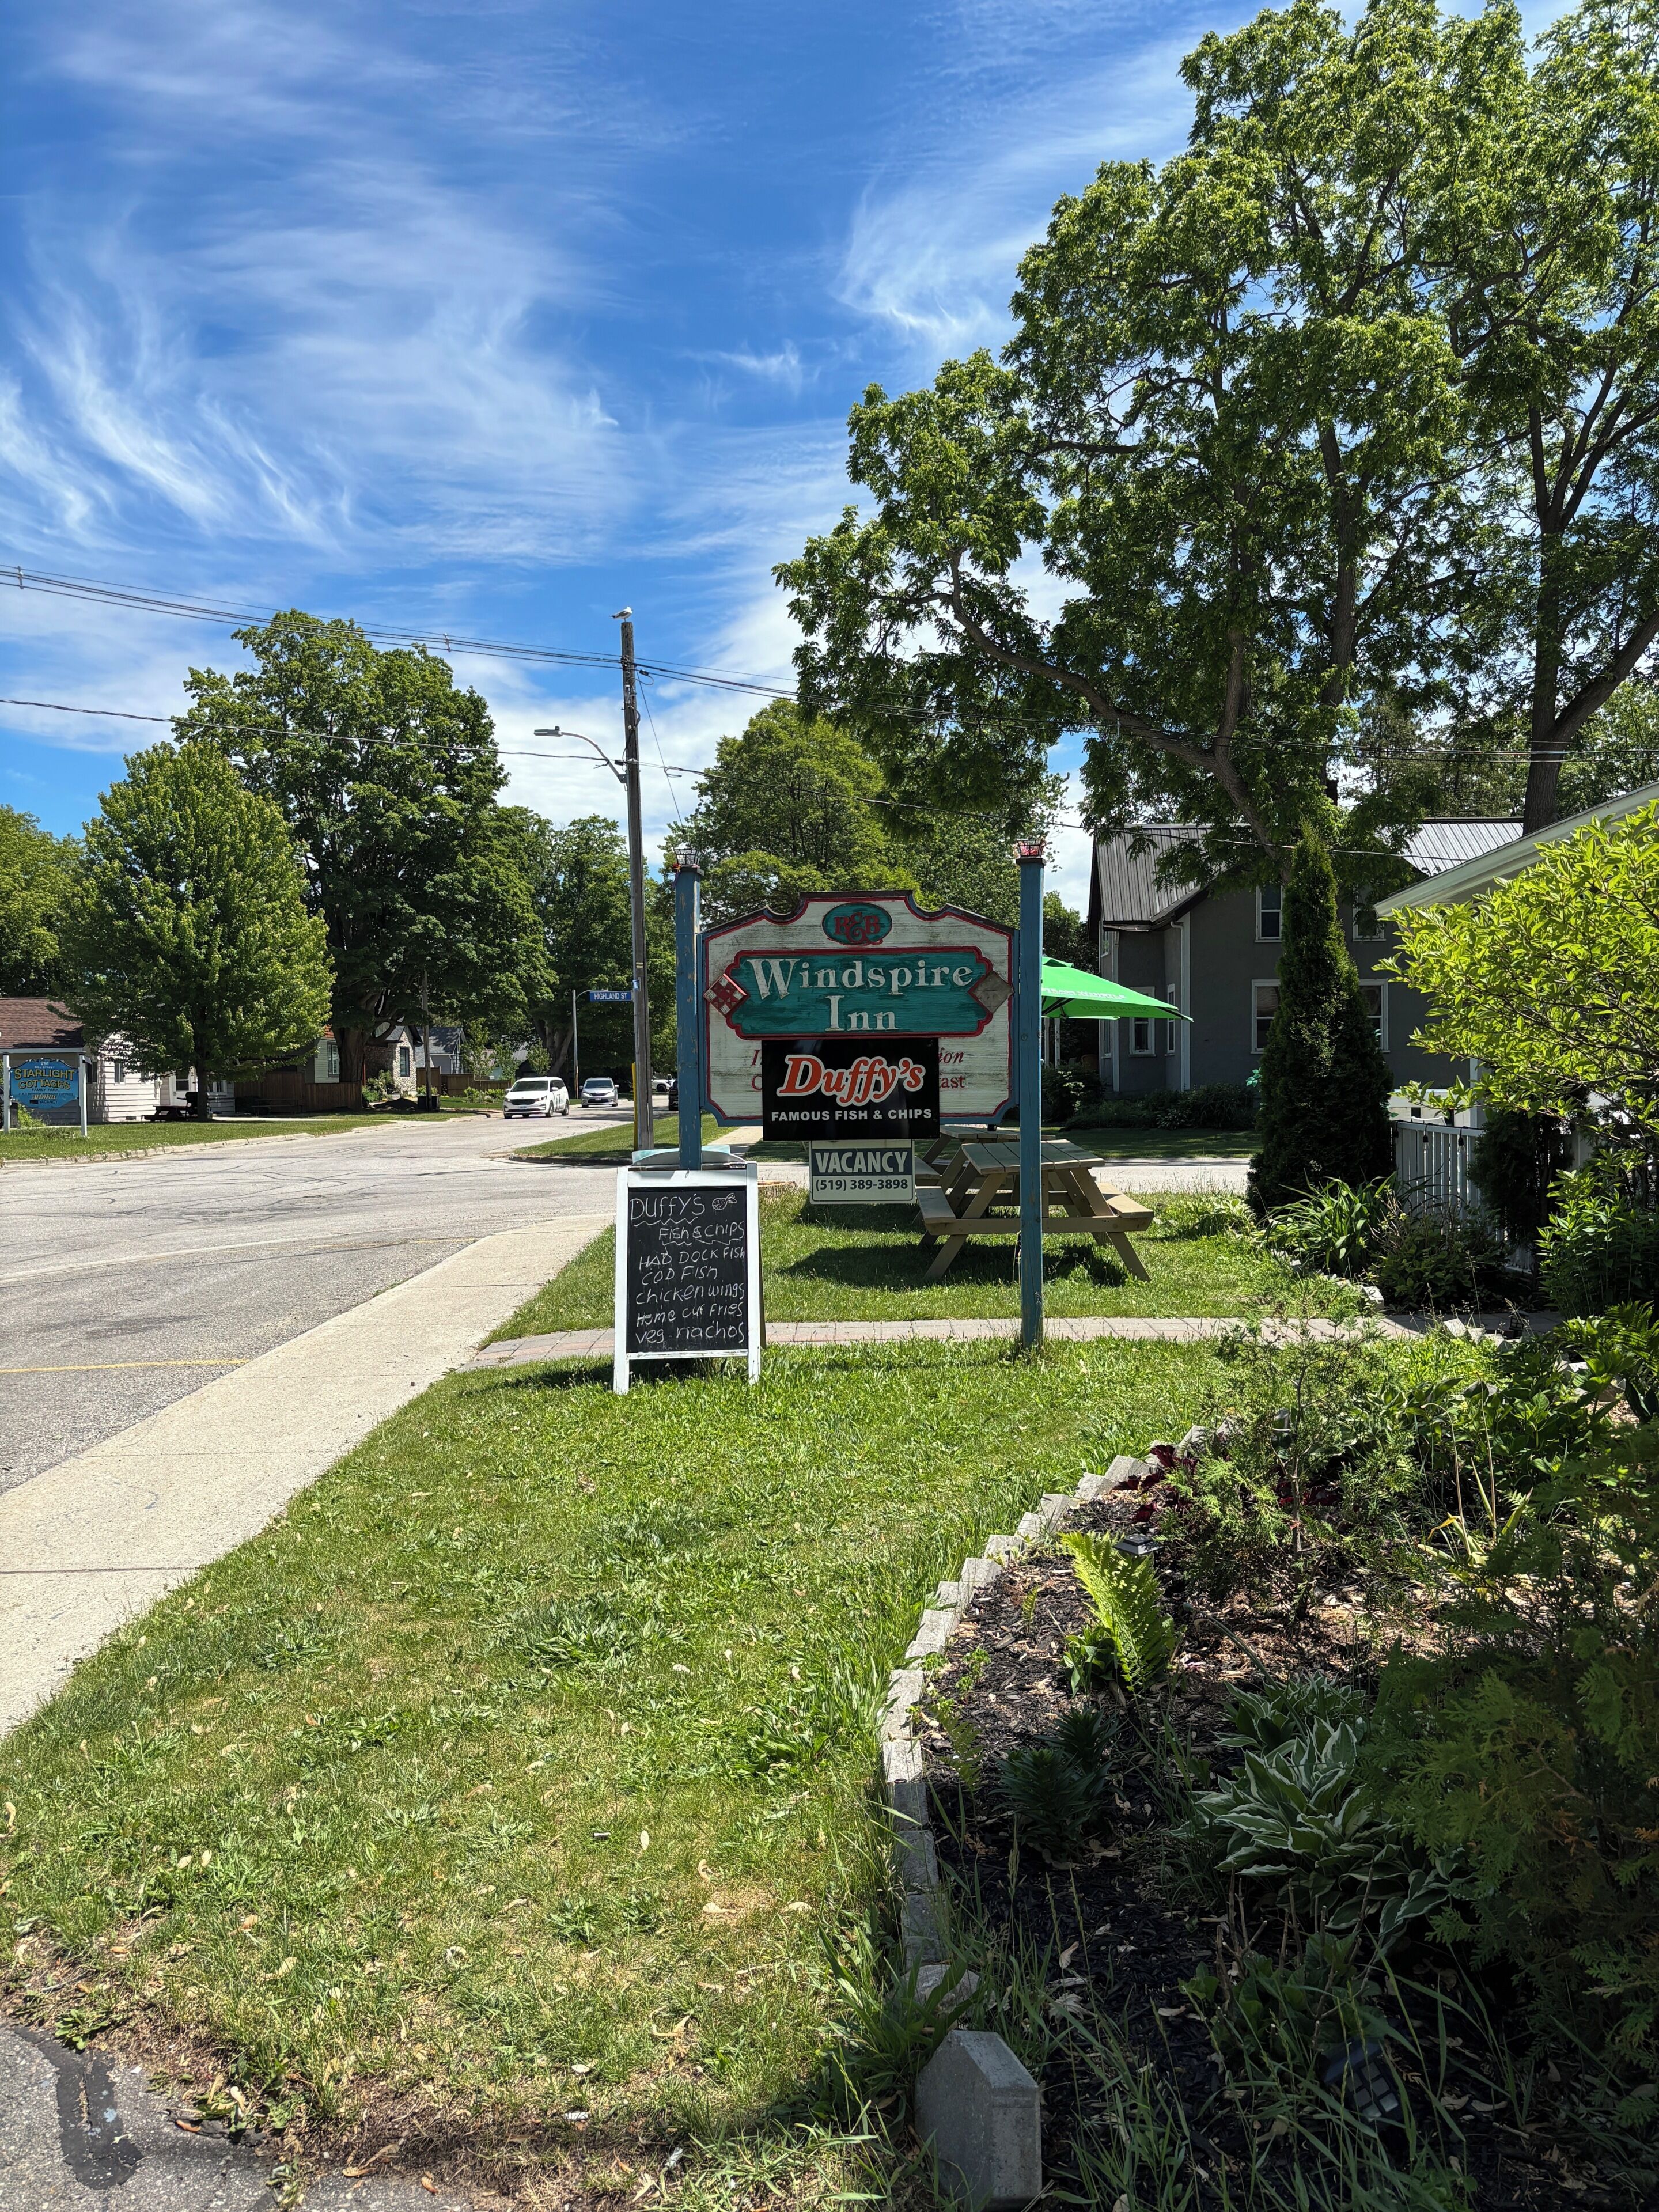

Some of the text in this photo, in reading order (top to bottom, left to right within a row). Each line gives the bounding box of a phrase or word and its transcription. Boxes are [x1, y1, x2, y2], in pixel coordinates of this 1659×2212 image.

[747, 958, 973, 999] Windspire
[824, 995, 899, 1031] Inn
[14, 1069, 75, 1081] STARLIGHT
[776, 1054, 926, 1107] Duffy's
[18, 1079, 71, 1090] COTTAGES
[771, 1109, 932, 1121] FAMOUS FISH & CHIPS
[815, 1151, 908, 1173] VACANCY
[816, 1179, 908, 1191] (519) 389-3898
[692, 1226, 702, 1238] &
[642, 1268, 675, 1286] COD
